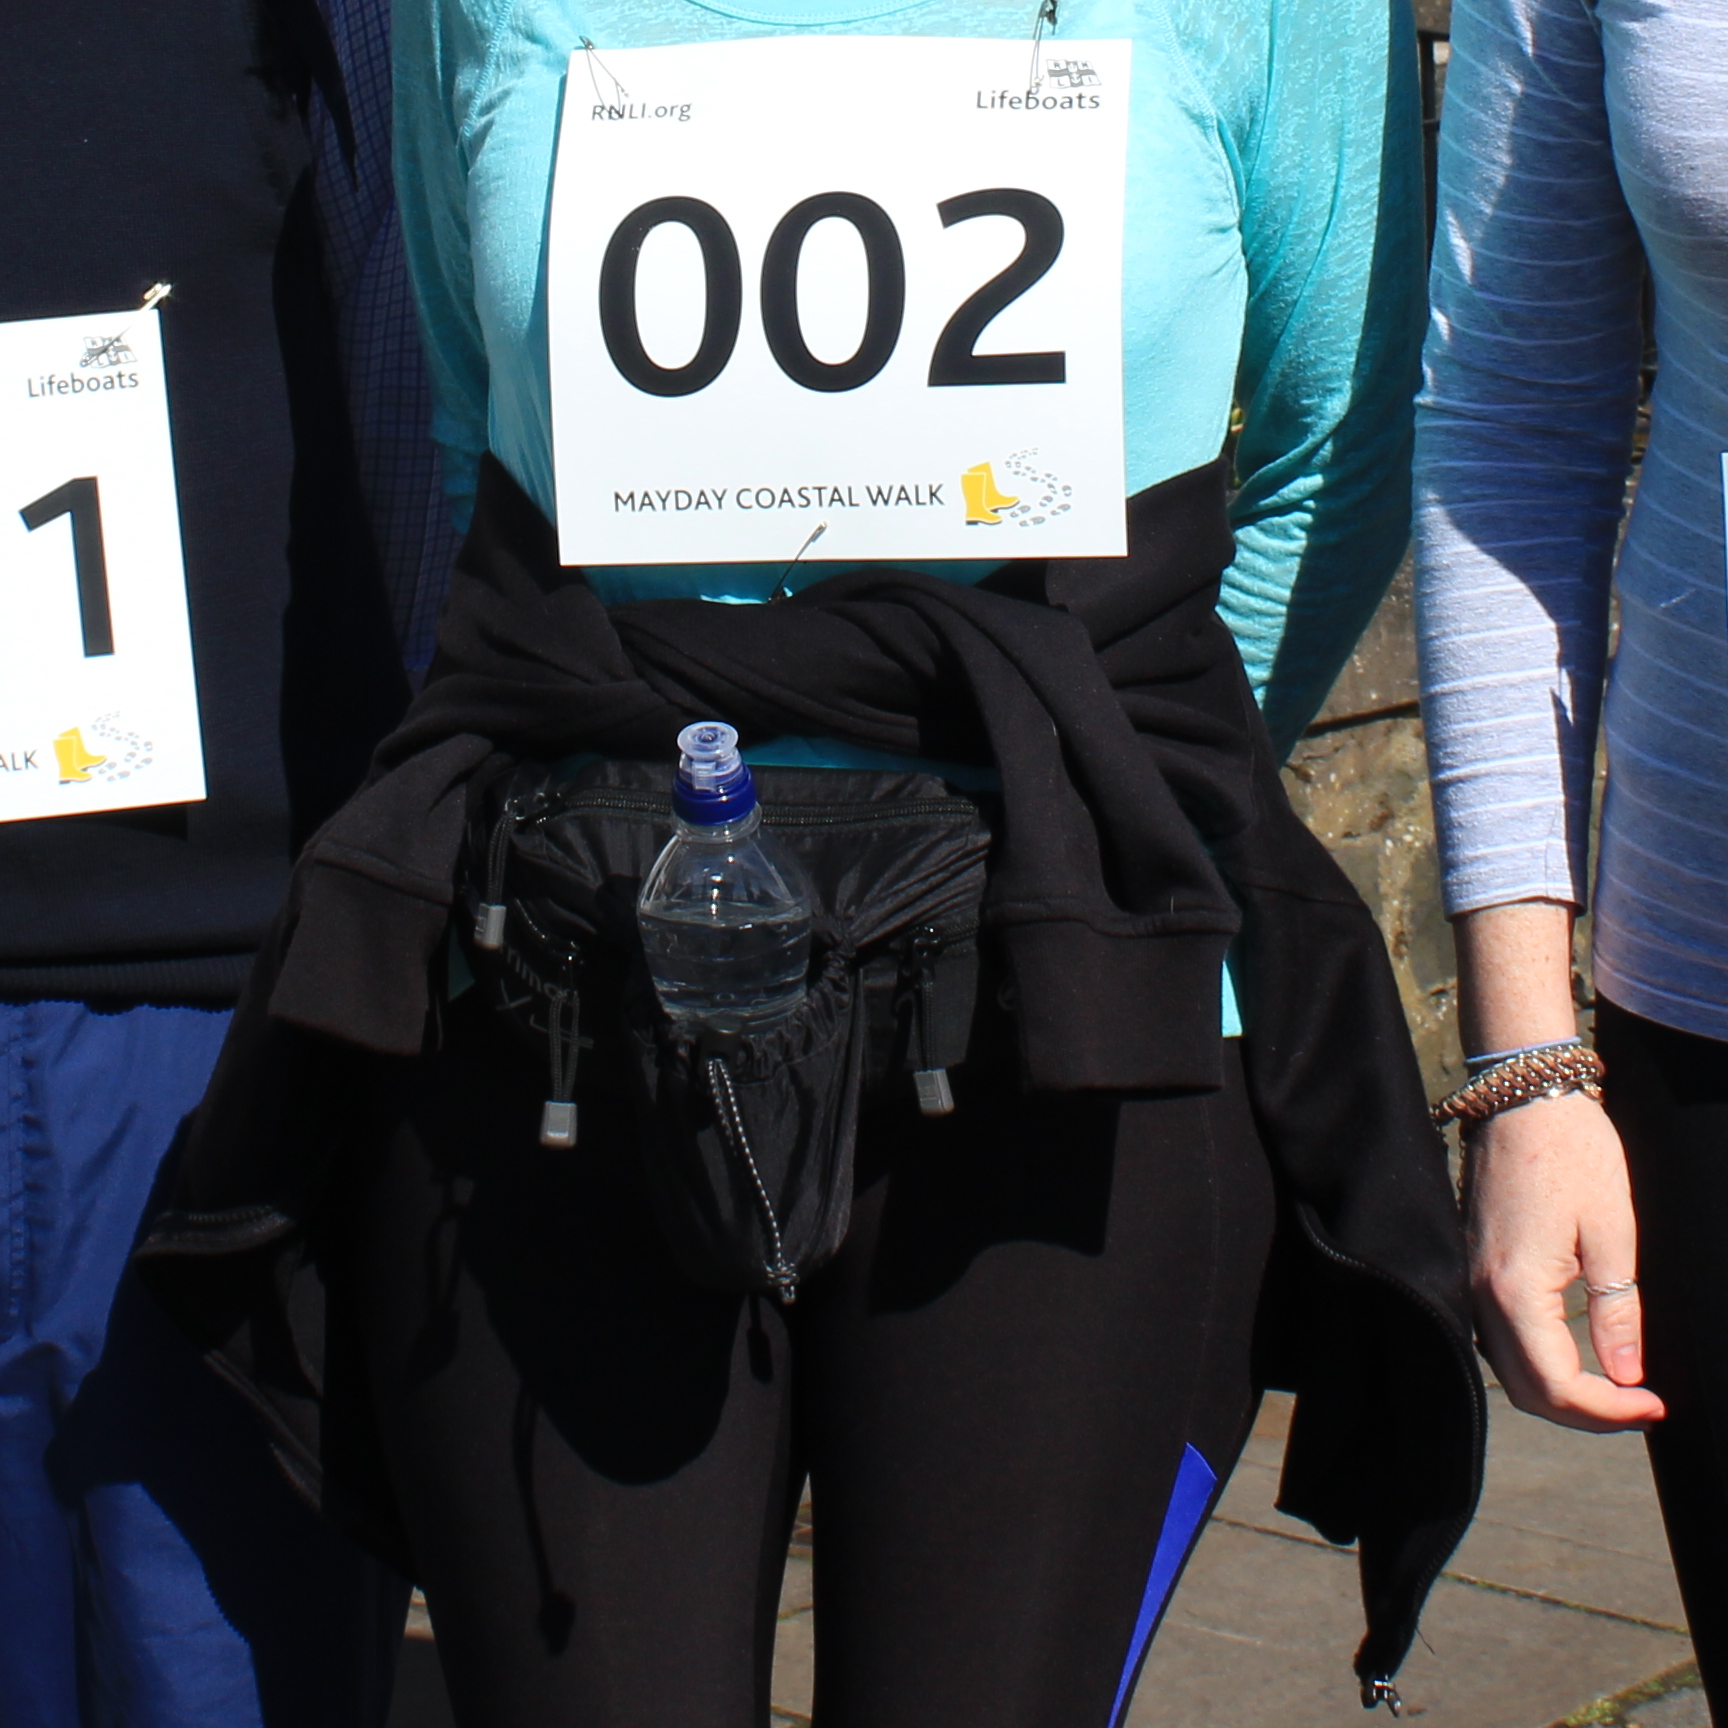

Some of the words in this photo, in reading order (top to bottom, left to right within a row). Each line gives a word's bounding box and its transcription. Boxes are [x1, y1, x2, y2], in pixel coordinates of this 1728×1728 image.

[590, 100, 693, 122] RNLI.org
[975, 89, 1101, 111] Lifeboats
[598, 187, 1067, 398] 002
[27, 370, 140, 399] Lifeboats
[613, 488, 728, 513] MAYDAY
[735, 485, 861, 511] COASTAL
[865, 483, 946, 507] WALK
